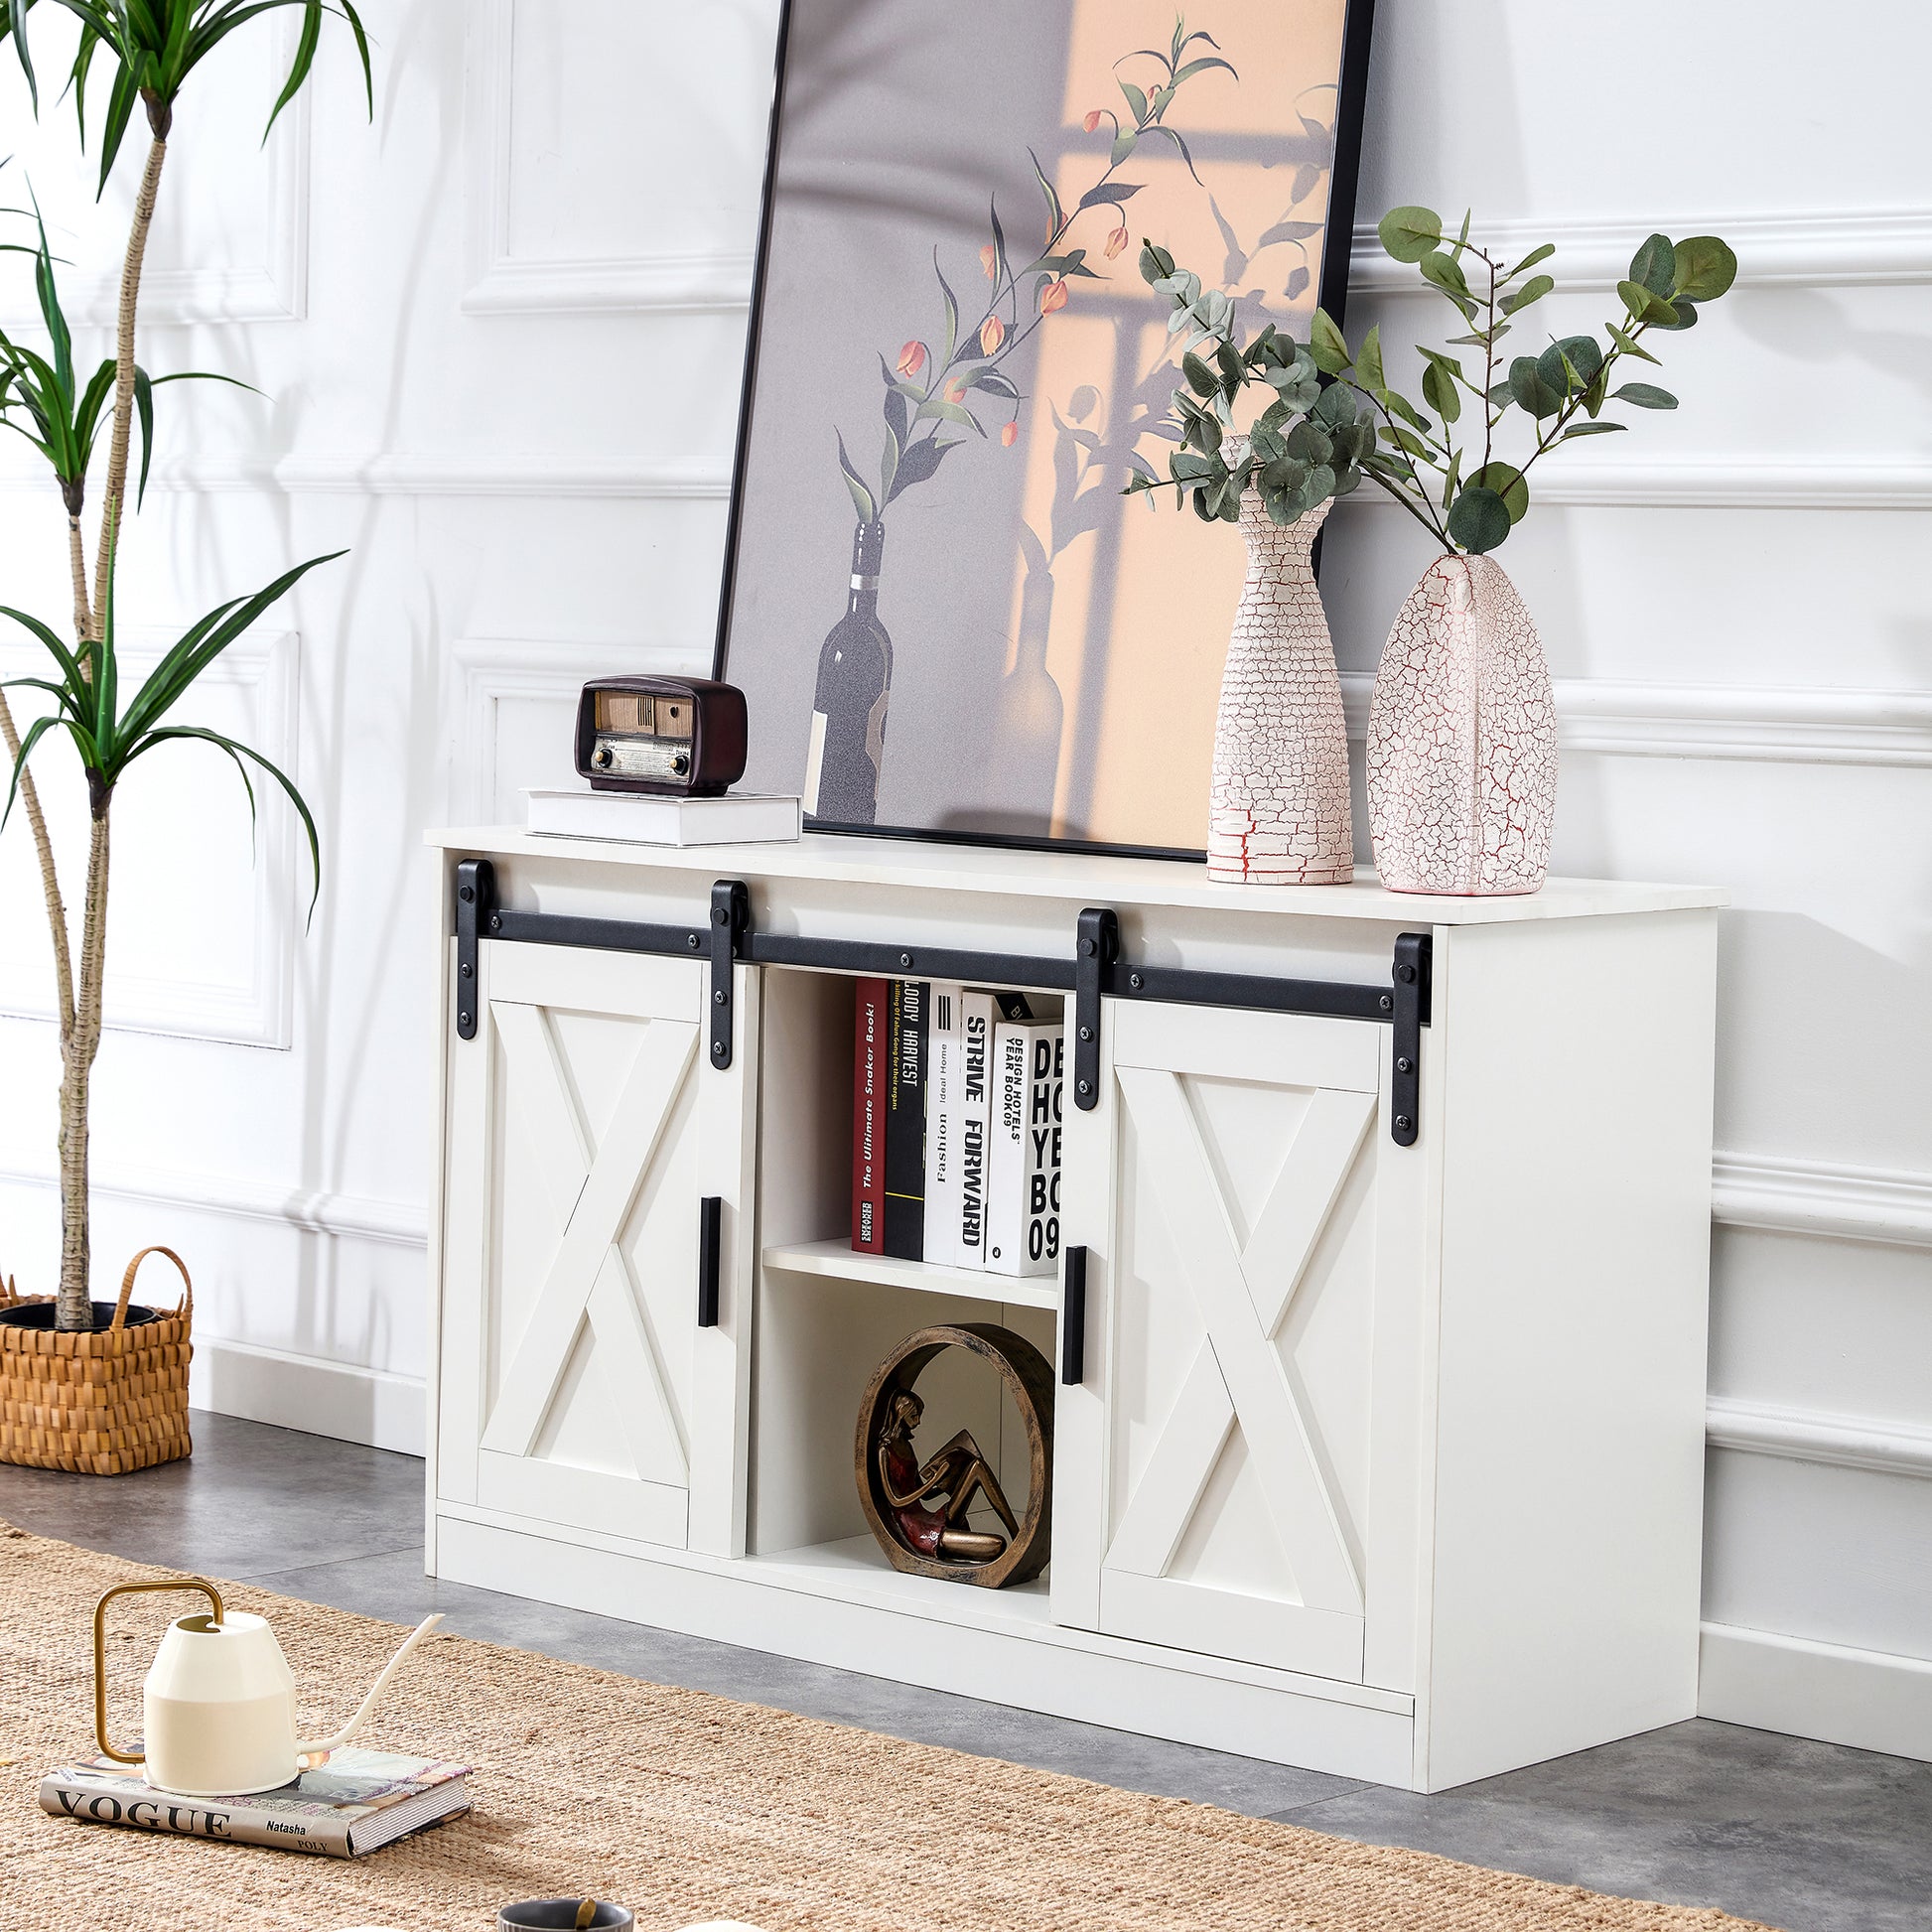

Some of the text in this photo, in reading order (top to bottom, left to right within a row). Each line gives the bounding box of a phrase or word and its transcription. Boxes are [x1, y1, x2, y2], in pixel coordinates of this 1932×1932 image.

[866, 1003, 875, 1042] Book!
[865, 1047, 874, 1095] Snaker
[902, 1030, 918, 1087] HARVEST
[1006, 1037, 1015, 1070] YEAR
[1013, 1038, 1024, 1085] DESIGN
[937, 1113, 947, 1182] Fashion
[963, 1016, 985, 1246] STRIVE FORWARD
[863, 1166, 872, 1188] The
[1029, 1217, 1059, 1261] 09
[56, 1789, 231, 1837] VOGUE
[266, 1820, 306, 1836] Natasha
[298, 1840, 328, 1852] POLY
